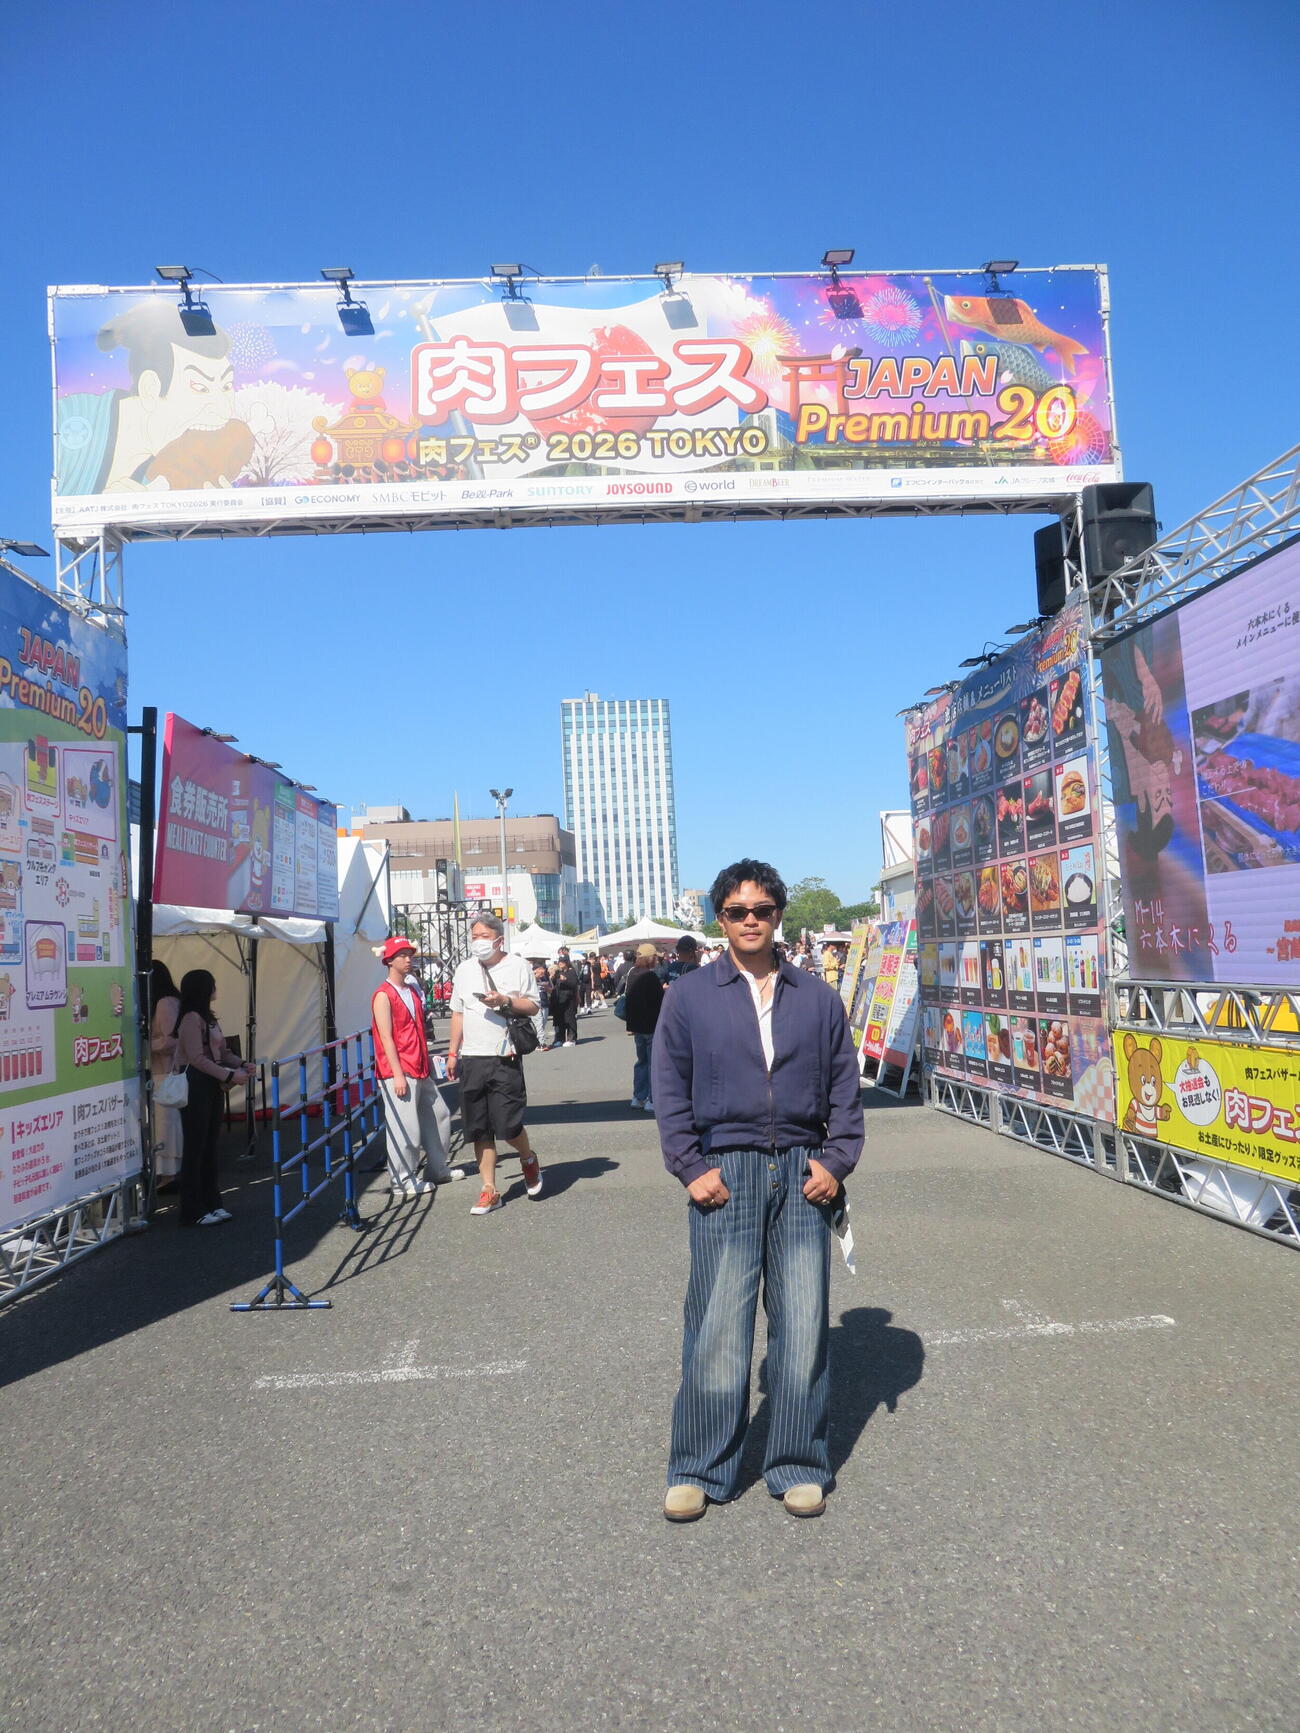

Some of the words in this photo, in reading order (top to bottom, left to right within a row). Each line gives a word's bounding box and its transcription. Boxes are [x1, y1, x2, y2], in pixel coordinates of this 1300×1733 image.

[412, 336, 767, 425] 肉フェス
[844, 355, 998, 398] JAPAN
[797, 402, 990, 442] Premium
[994, 384, 1076, 440] 20
[549, 431, 638, 461] 2026
[646, 427, 768, 458] TOKYO
[606, 482, 673, 495] JOYSOUND
[18, 627, 80, 691] JAPAN
[0, 655, 77, 727] Premium
[78, 686, 107, 739] 20
[170, 776, 228, 832] 食券販売所
[74, 1034, 124, 1068] 肉フェス
[1245, 1067, 1300, 1081] 肉フェスバザー
[17, 1110, 64, 1138] キッズエリア
[77, 1093, 130, 1121] 肉フェスバザール
[1224, 1087, 1300, 1143] 肉フェ
